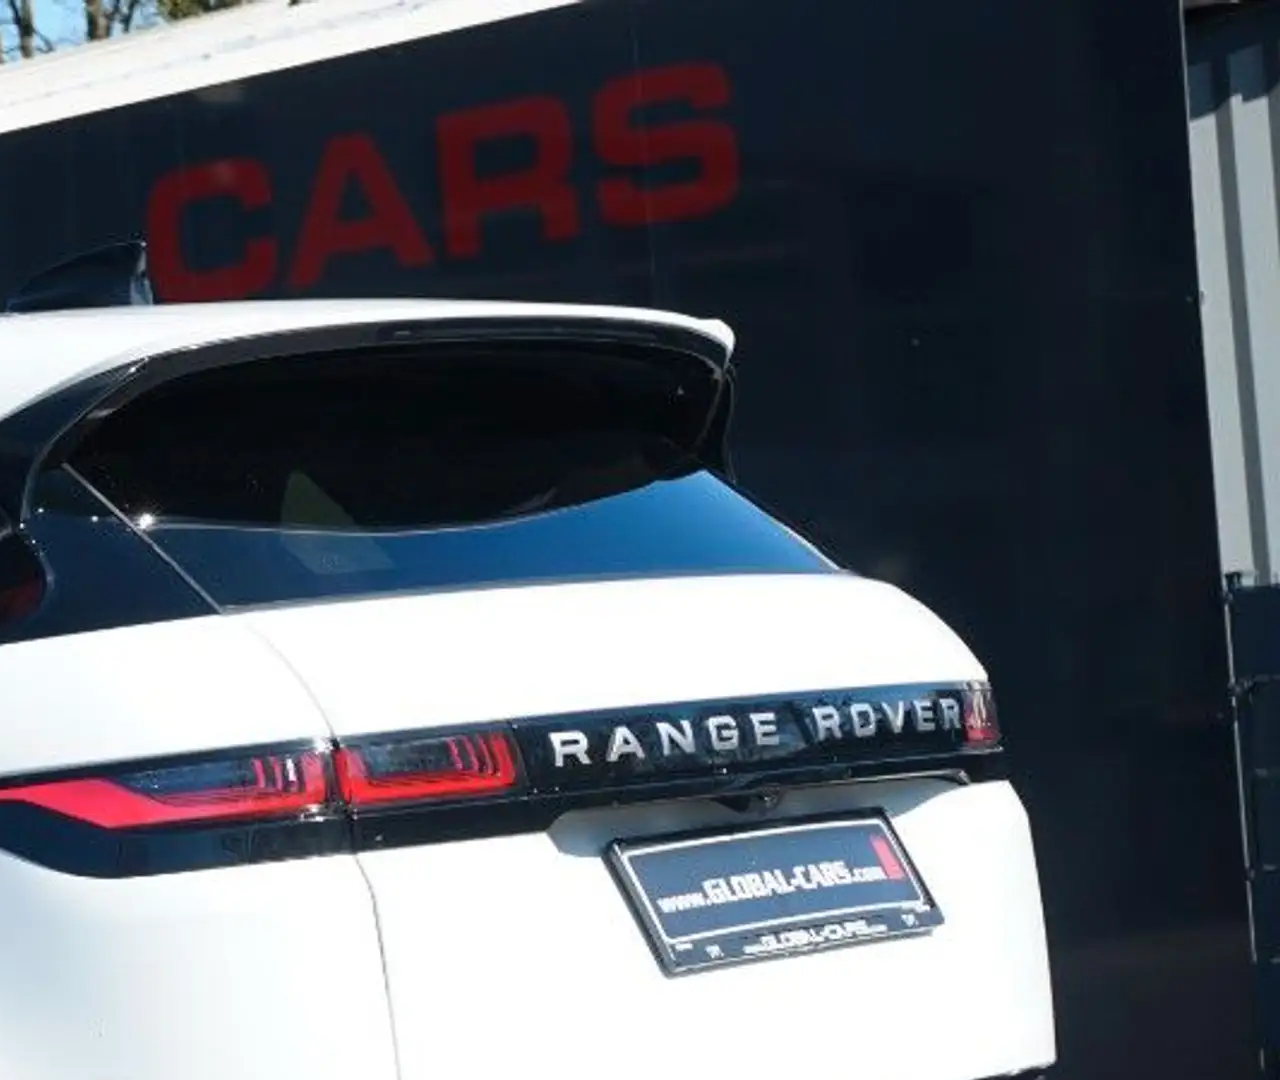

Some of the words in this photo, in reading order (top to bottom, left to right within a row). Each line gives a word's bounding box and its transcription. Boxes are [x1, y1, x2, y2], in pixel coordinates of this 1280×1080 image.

[146, 61, 740, 301] CARS
[548, 711, 781, 768] RANGE
[811, 697, 962, 743] ROVER
